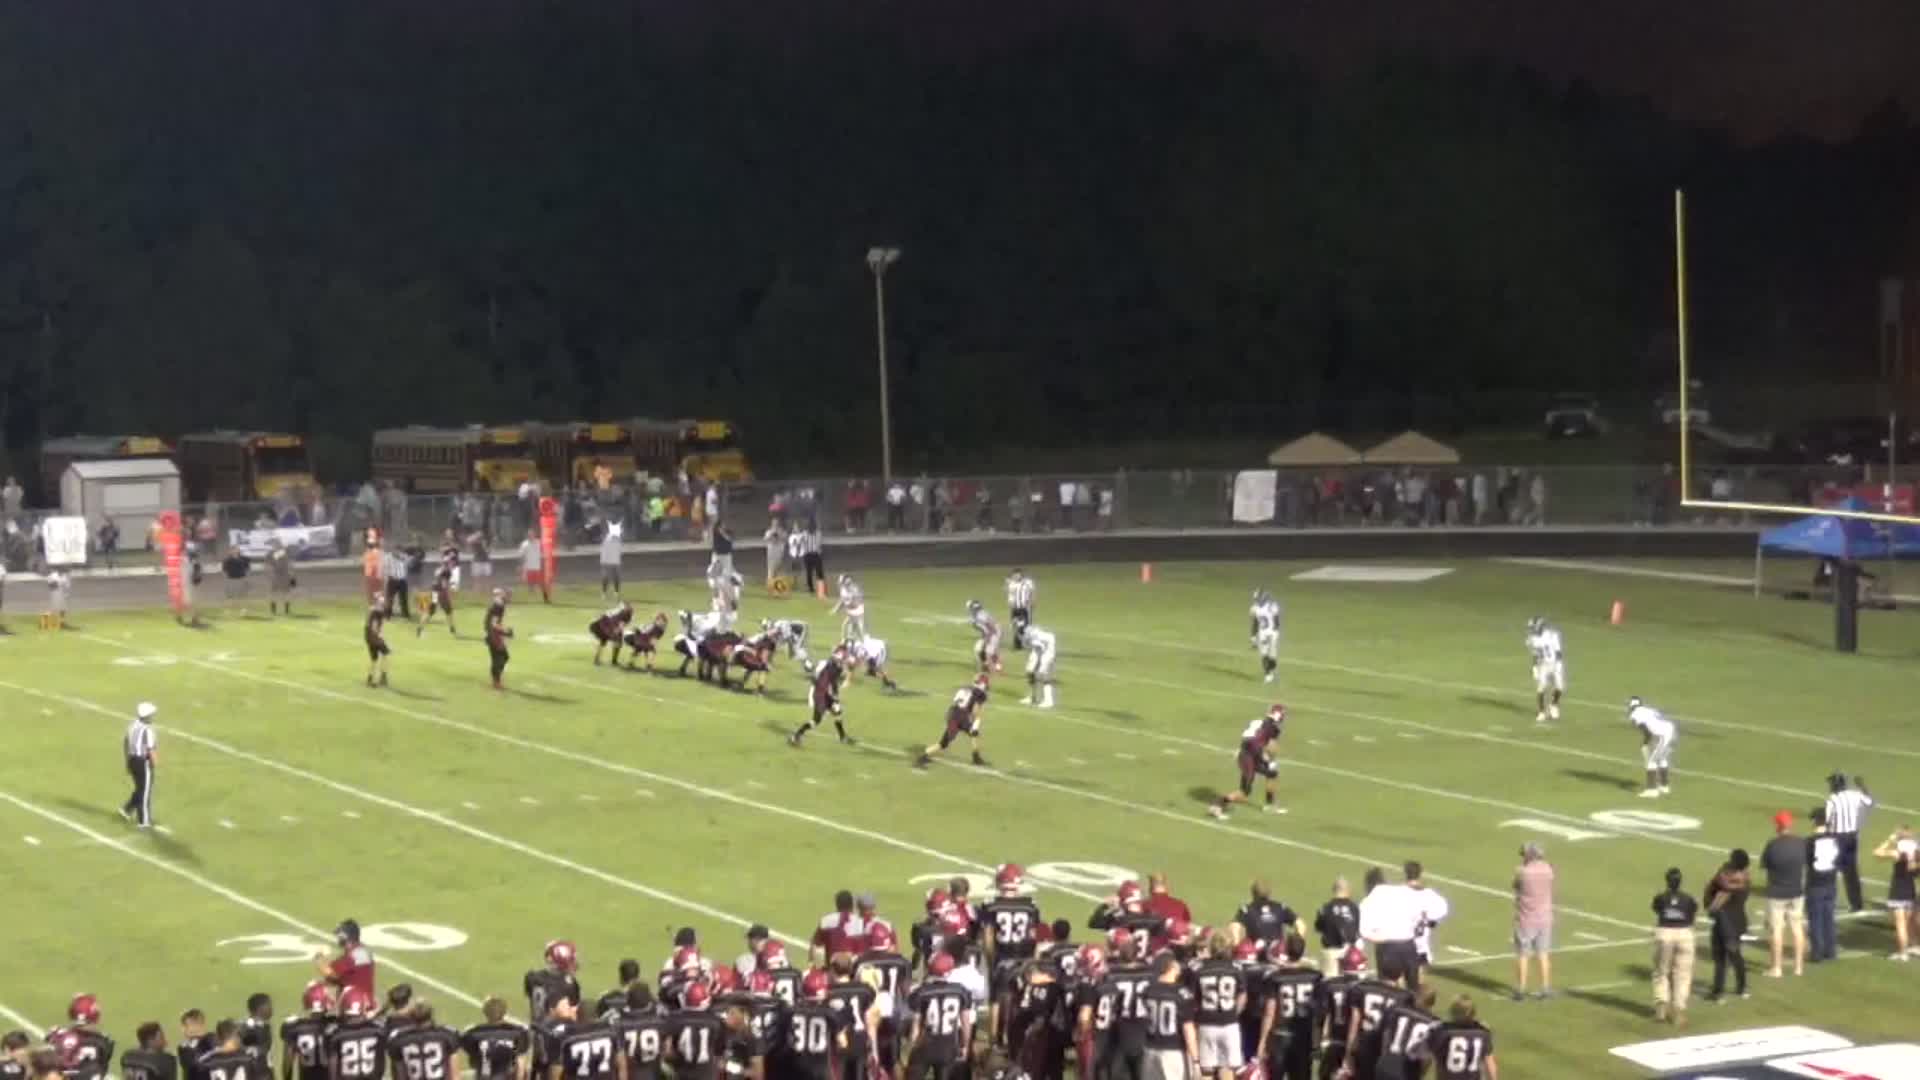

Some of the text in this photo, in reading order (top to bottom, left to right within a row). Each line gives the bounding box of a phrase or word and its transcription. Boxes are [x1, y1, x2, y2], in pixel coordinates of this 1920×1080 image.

[996, 912, 1029, 943] 33
[1199, 975, 1237, 1011] 59
[791, 1013, 828, 1053] 30
[926, 998, 961, 1035] 42
[341, 1036, 378, 1076] 25
[403, 1041, 443, 1080] 62
[570, 1037, 612, 1077] 77
[624, 1028, 660, 1062] 79
[678, 1026, 710, 1064] 41
[1446, 1036, 1483, 1073] 61
